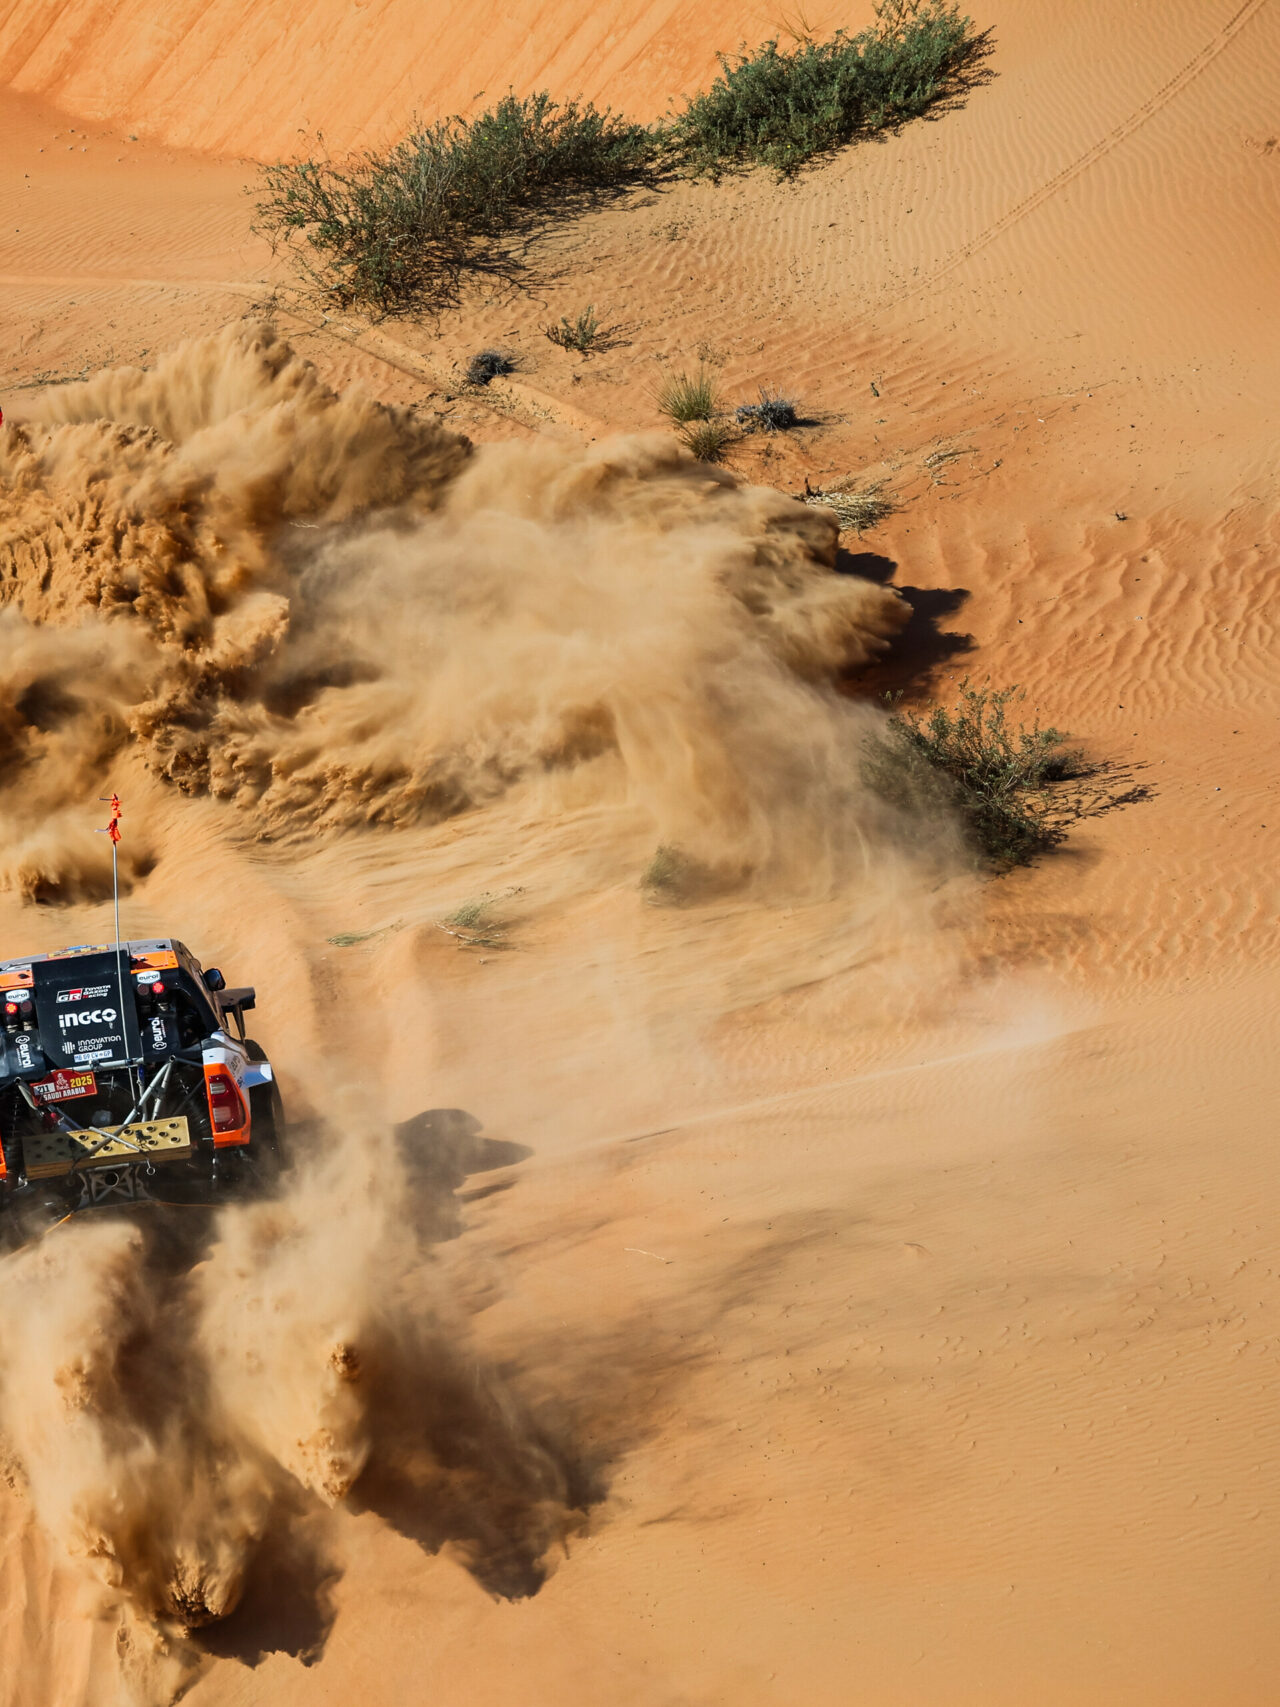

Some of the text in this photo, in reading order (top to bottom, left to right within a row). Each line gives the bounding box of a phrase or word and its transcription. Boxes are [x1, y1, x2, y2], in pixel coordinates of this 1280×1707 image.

[138, 973, 159, 981] eurol
[8, 992, 28, 1000] eurol
[58, 992, 81, 1002] GR
[148, 1016, 163, 1042] eurol
[77, 1035, 122, 1047] INNOVATION
[78, 1043, 103, 1053] GROUP
[19, 1043, 35, 1068] eurol
[70, 1075, 93, 1088] 2025
[43, 1086, 86, 1101] SAUDI ARABIA
